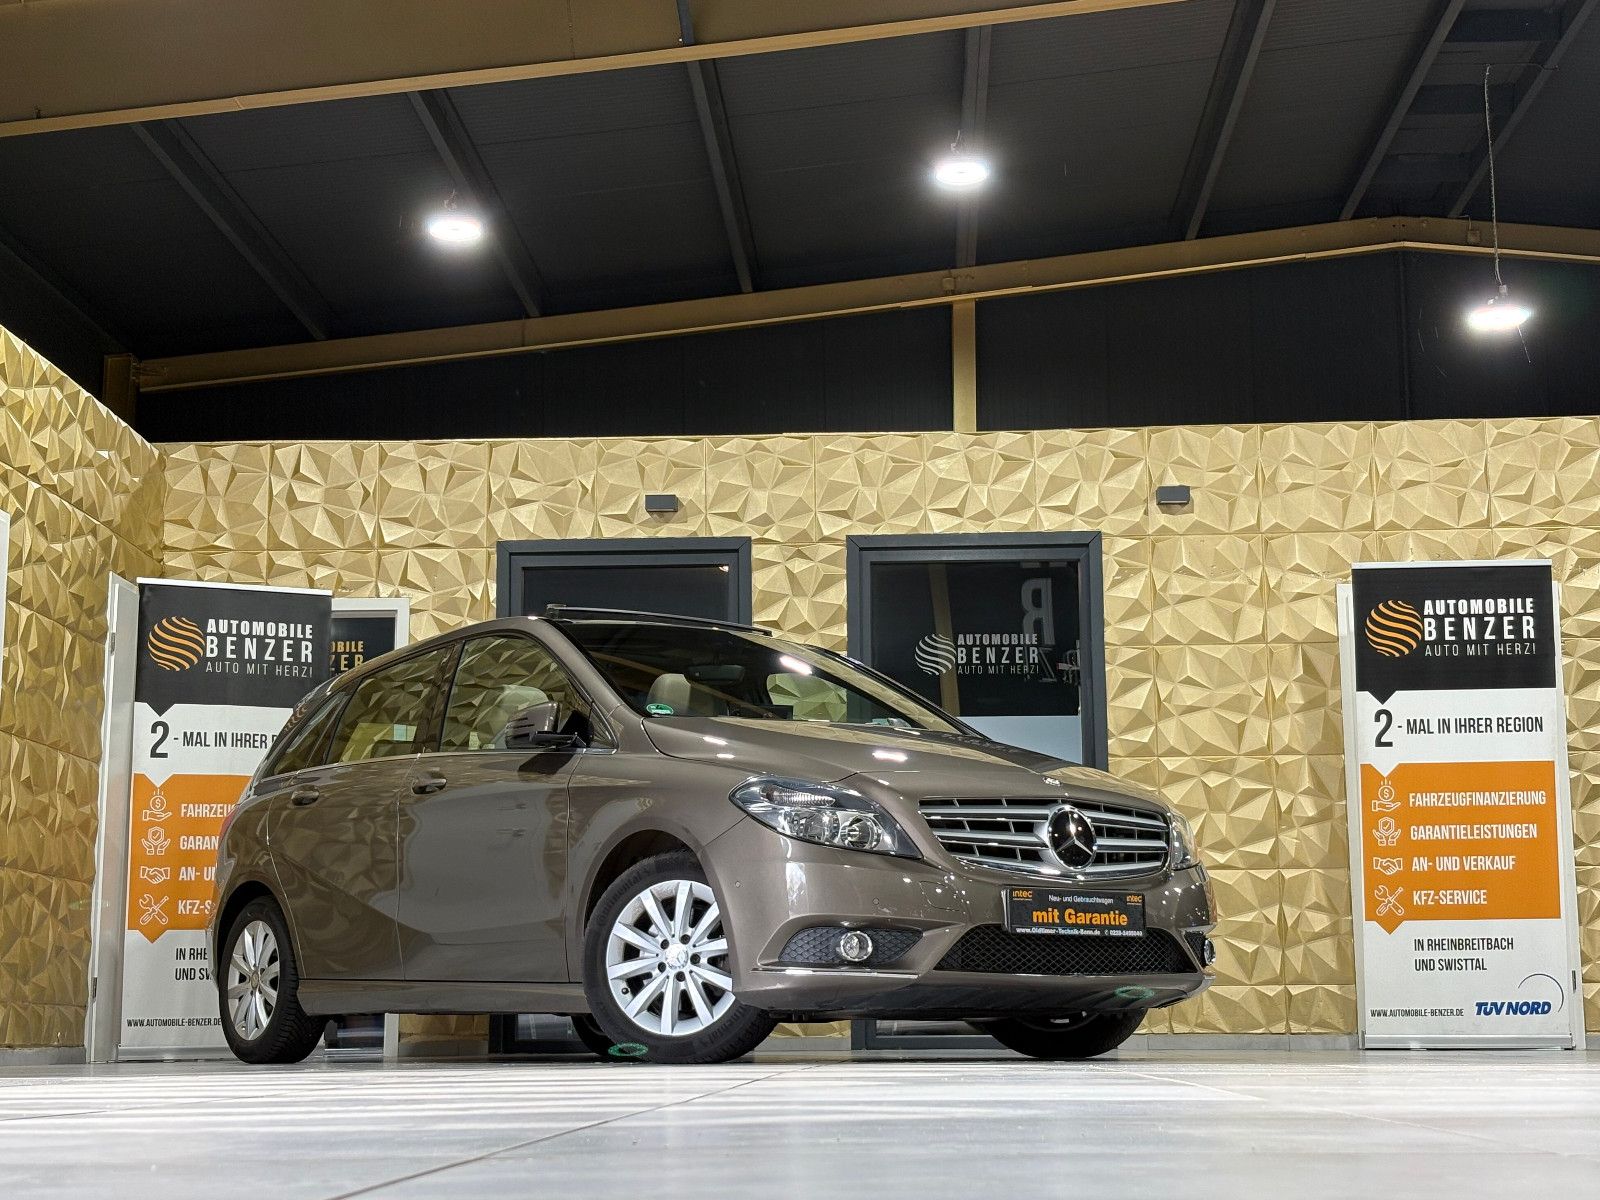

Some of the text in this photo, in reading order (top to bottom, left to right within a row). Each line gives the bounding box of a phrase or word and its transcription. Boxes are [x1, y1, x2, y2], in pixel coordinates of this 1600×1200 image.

[1423, 598, 1534, 616] AUTOMOBILE
[206, 618, 313, 639] AUTOMOBILE
[1423, 615, 1535, 641] BENZER
[957, 634, 1038, 645] AUTOMOBILE
[205, 635, 313, 663] BENZER
[957, 646, 1039, 664] BENZER
[1424, 643, 1459, 657] AUTO
[1466, 642, 1489, 656] MIT
[205, 661, 239, 674] AUTO
[246, 662, 268, 676] MIT
[957, 665, 983, 675] AUTO
[988, 665, 1005, 675] MIT
[1374, 709, 1394, 748] 2
[1406, 718, 1434, 735] MAL
[1437, 718, 1451, 734] IN
[1455, 717, 1493, 734] IHRER
[1496, 716, 1543, 733] REGION
[150, 720, 170, 759] 2
[182, 731, 211, 748] MAL
[214, 732, 228, 748] IN
[231, 733, 268, 750] IHRER
[1409, 791, 1547, 808] FAHRZEUGFINANZIERUNG
[1410, 824, 1538, 841] GARANTIELEISTUNGEN
[1412, 856, 1516, 871] AN- UND VERKAUF
[179, 867, 201, 881] AN-
[1048, 894, 1114, 906] Neu- und Gebrauchtwagen
[1413, 890, 1488, 906] KFZ-SERVICE
[1032, 907, 1128, 926] mit Garantie
[1414, 937, 1514, 951] IN RHEINBREITBACH
[175, 947, 186, 961] IN
[1414, 957, 1488, 972] UND SWISTTAL
[175, 967, 196, 981] UND
[1370, 1008, 1464, 1017] WWW.AUTOMOBILE-BENZER.DE
[1505, 1001, 1552, 1015] NORD
[126, 1018, 222, 1027] WWW.AUTOMOBILE-BENZER.DE
